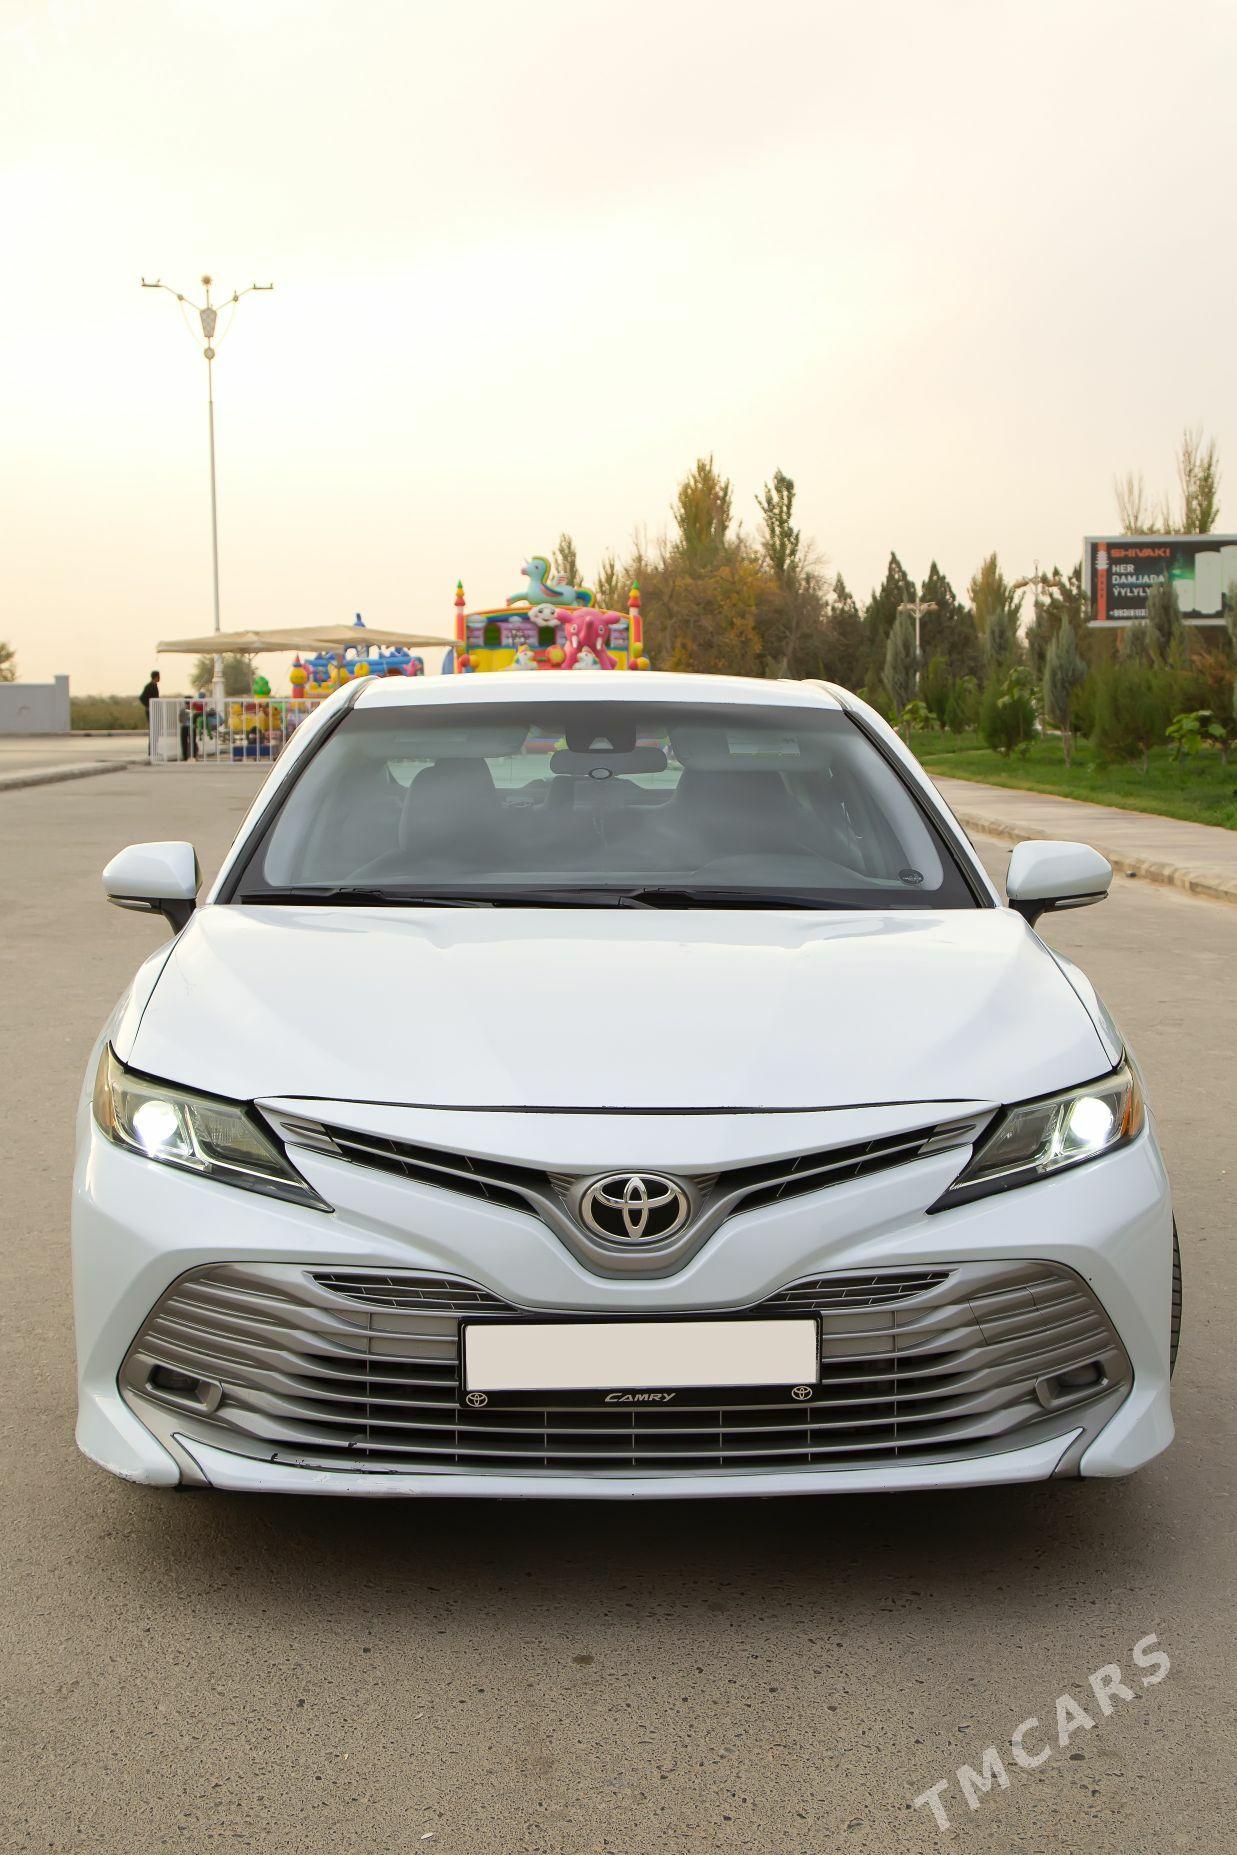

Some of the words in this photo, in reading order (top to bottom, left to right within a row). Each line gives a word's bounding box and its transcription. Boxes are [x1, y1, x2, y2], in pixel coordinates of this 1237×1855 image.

[1111, 548, 1170, 557] SHIVAKI
[1112, 564, 1135, 573] HER
[1112, 574, 1165, 584] DAMJADA
[604, 1392, 676, 1403] CAMRY
